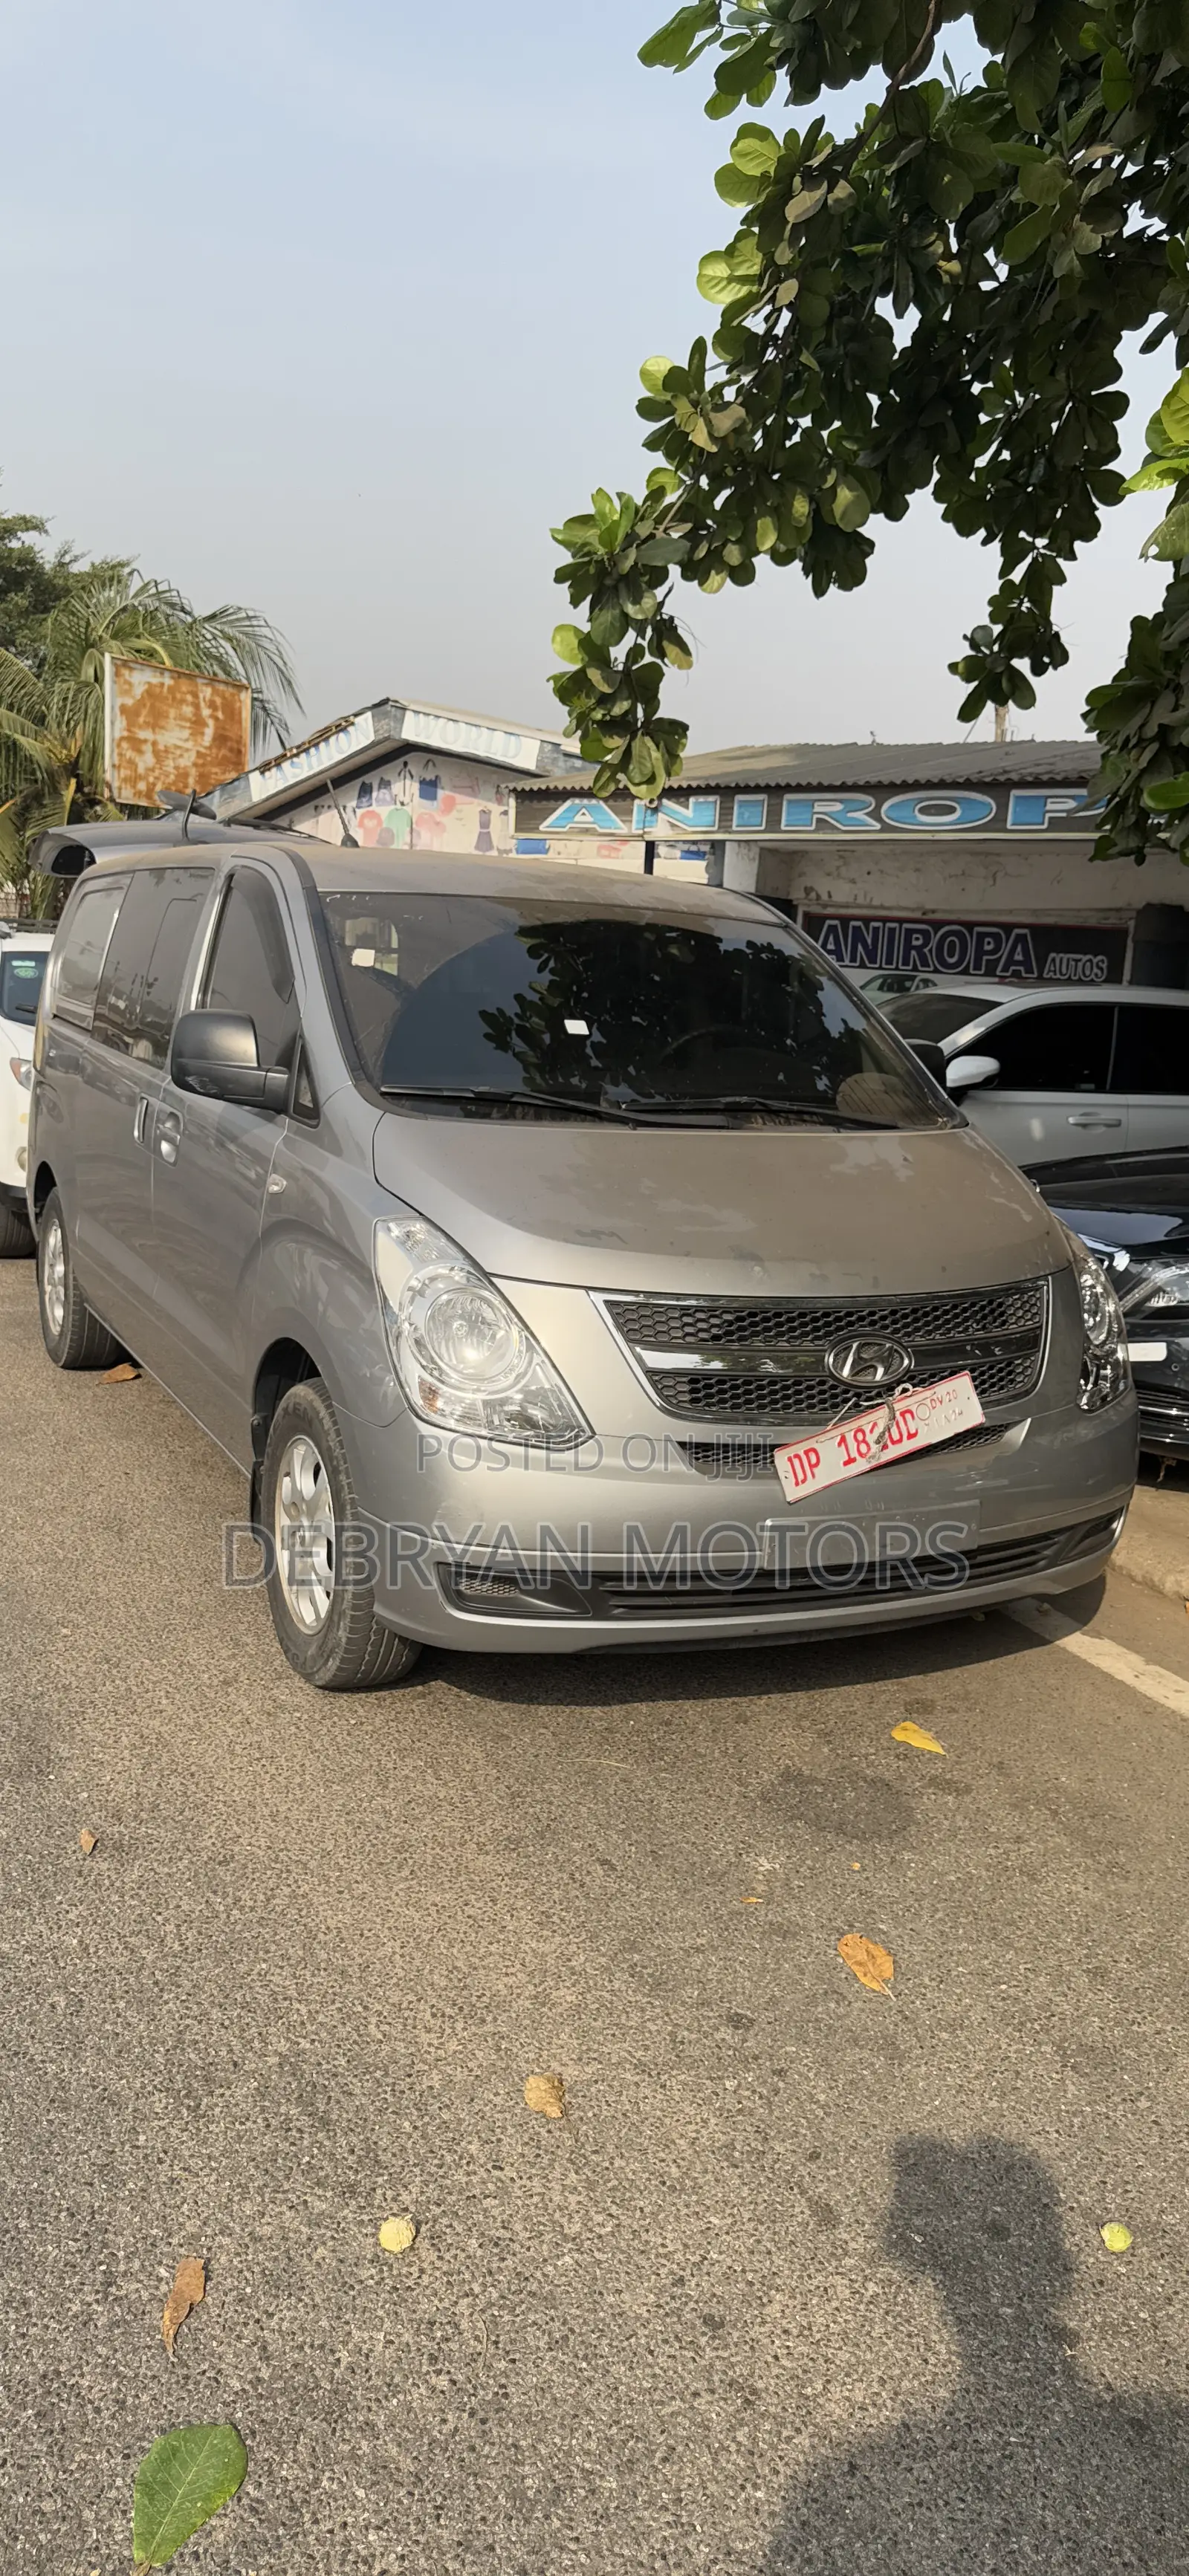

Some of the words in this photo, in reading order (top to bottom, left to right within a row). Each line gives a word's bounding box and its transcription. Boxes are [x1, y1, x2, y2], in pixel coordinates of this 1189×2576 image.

[262, 717, 371, 794] FASHION
[412, 711, 522, 759] WORLD
[539, 789, 1182, 831] ANIROP
[817, 920, 1037, 978] ANIROPA
[1043, 953, 1107, 982] AUTOS
[786, 1447, 820, 1487] DP
